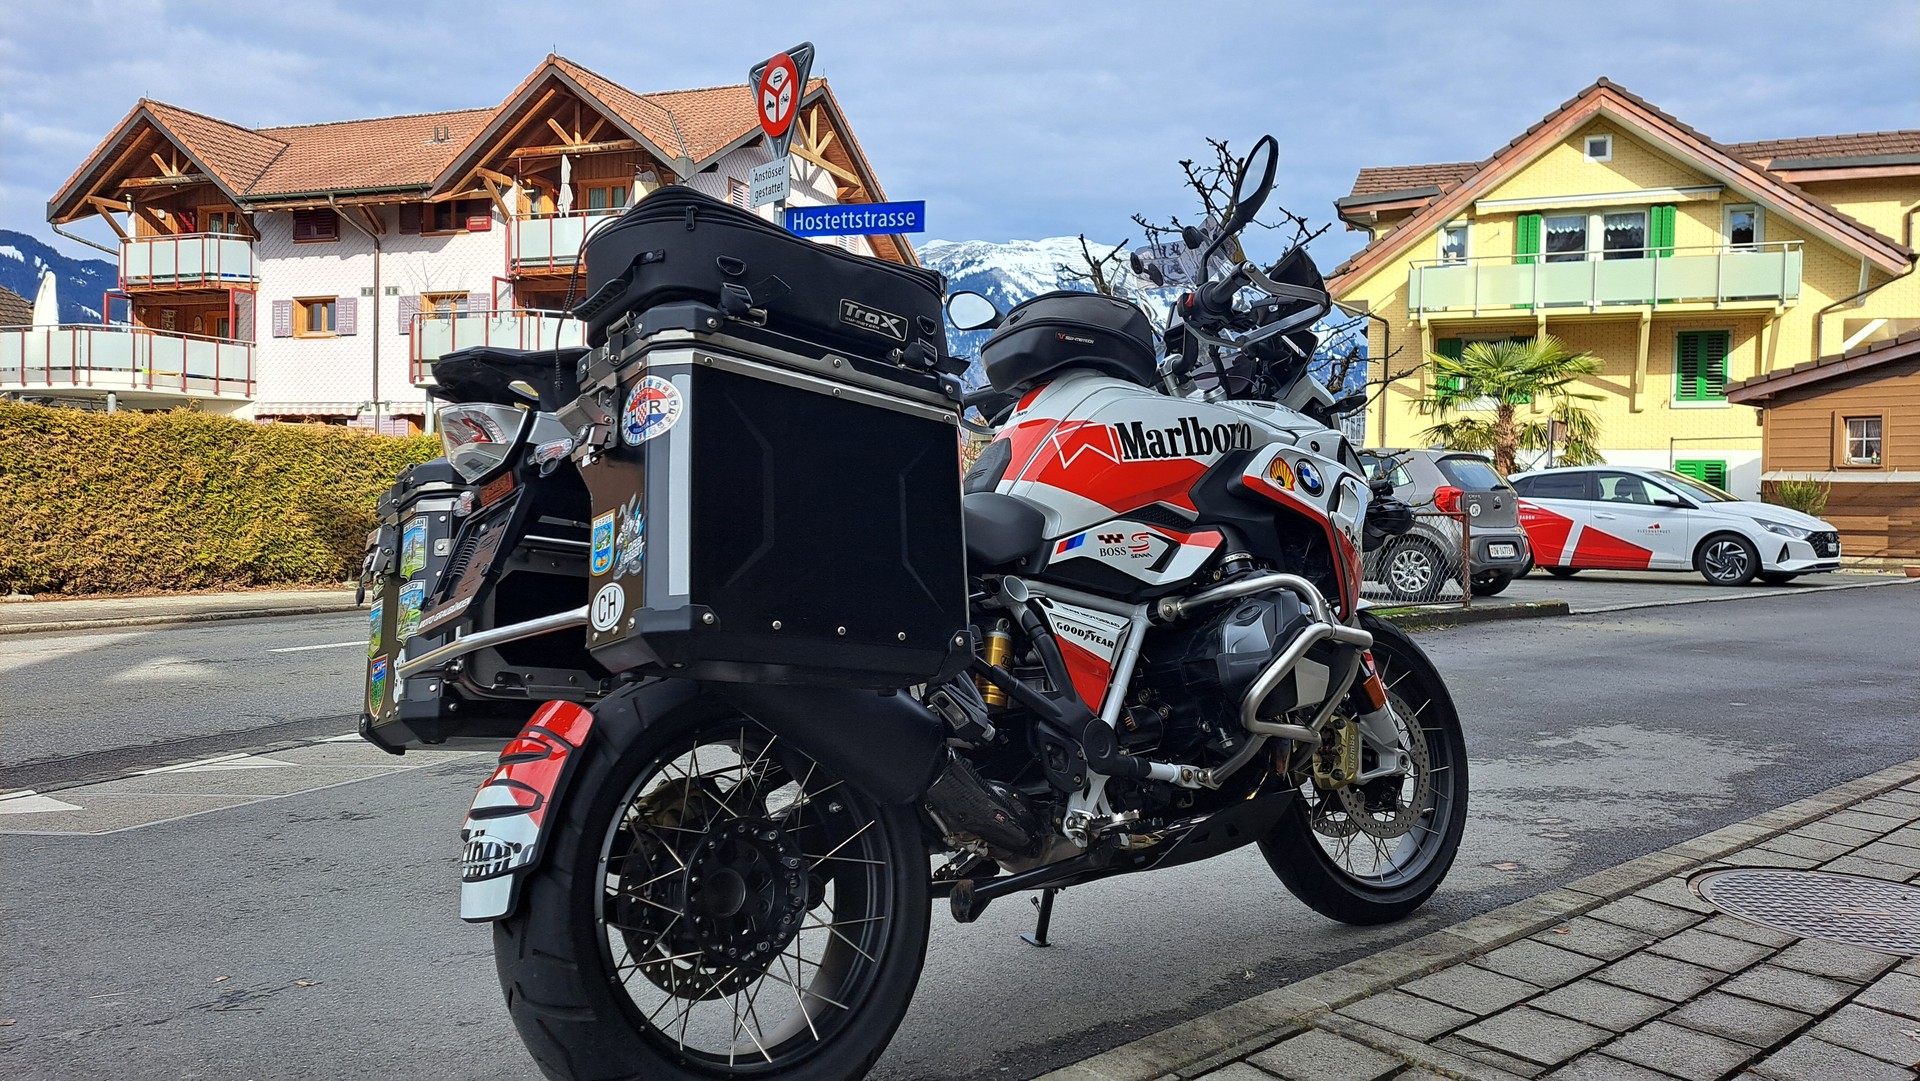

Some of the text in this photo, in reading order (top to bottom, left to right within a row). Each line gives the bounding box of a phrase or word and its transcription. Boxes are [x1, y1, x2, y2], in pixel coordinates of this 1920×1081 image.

[754, 164, 785, 184] Anstösser
[754, 181, 784, 202] gestattet
[793, 211, 916, 231] Hostettstrasse
[1114, 416, 1252, 460] Marlboro
[1471, 505, 1479, 515] CH
[1099, 546, 1127, 557] BOSS
[598, 589, 617, 624] CH
[1056, 621, 1115, 649] GOODYEAR
